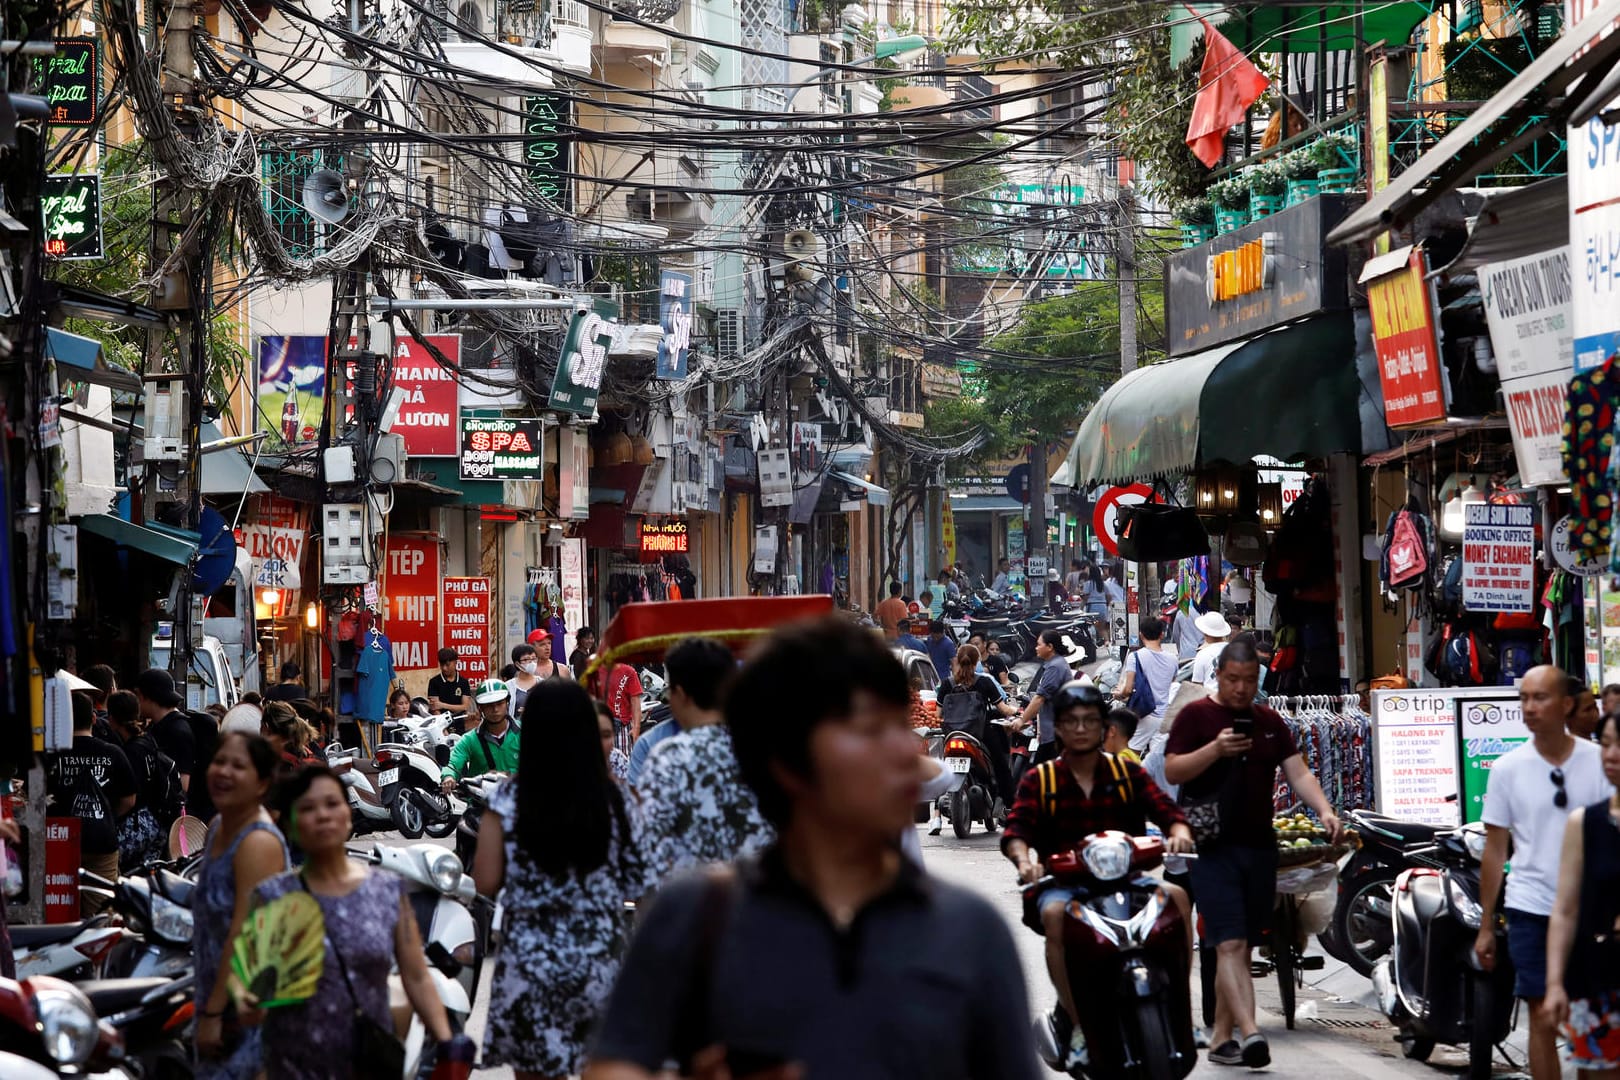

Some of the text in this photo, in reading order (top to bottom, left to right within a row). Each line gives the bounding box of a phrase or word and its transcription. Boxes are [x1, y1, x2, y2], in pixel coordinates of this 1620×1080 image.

[1588, 113, 1620, 169] SP
[1493, 252, 1572, 319] OCEAN SUN TOURS
[391, 367, 454, 381] HANG
[465, 422, 516, 432] SNOWDROP
[471, 431, 532, 451] SPA
[464, 451, 494, 462] BODY
[464, 463, 494, 475] FOOT
[1465, 505, 1532, 526] OCEAN SUN TOURS
[1465, 529, 1532, 542] BOOKING OFFICE
[390, 544, 424, 575] TÉP
[1465, 544, 1532, 565] MONEY EXCHANGE
[263, 560, 288, 572] 40K
[471, 580, 488, 592] GÀ
[454, 596, 479, 608] BÚN
[395, 596, 436, 627] THỊT
[447, 614, 486, 624] THANG
[451, 627, 482, 639] MIẾN
[391, 642, 428, 667] MAI
[452, 645, 482, 655] ƯƠN
[470, 659, 486, 671] GÀ
[468, 675, 488, 687] CH
[1414, 715, 1435, 723] BIG
[1391, 729, 1445, 738] HALONG BAY
[64, 756, 112, 766] TRAVELERS
[1416, 768, 1454, 776] TREKKING
